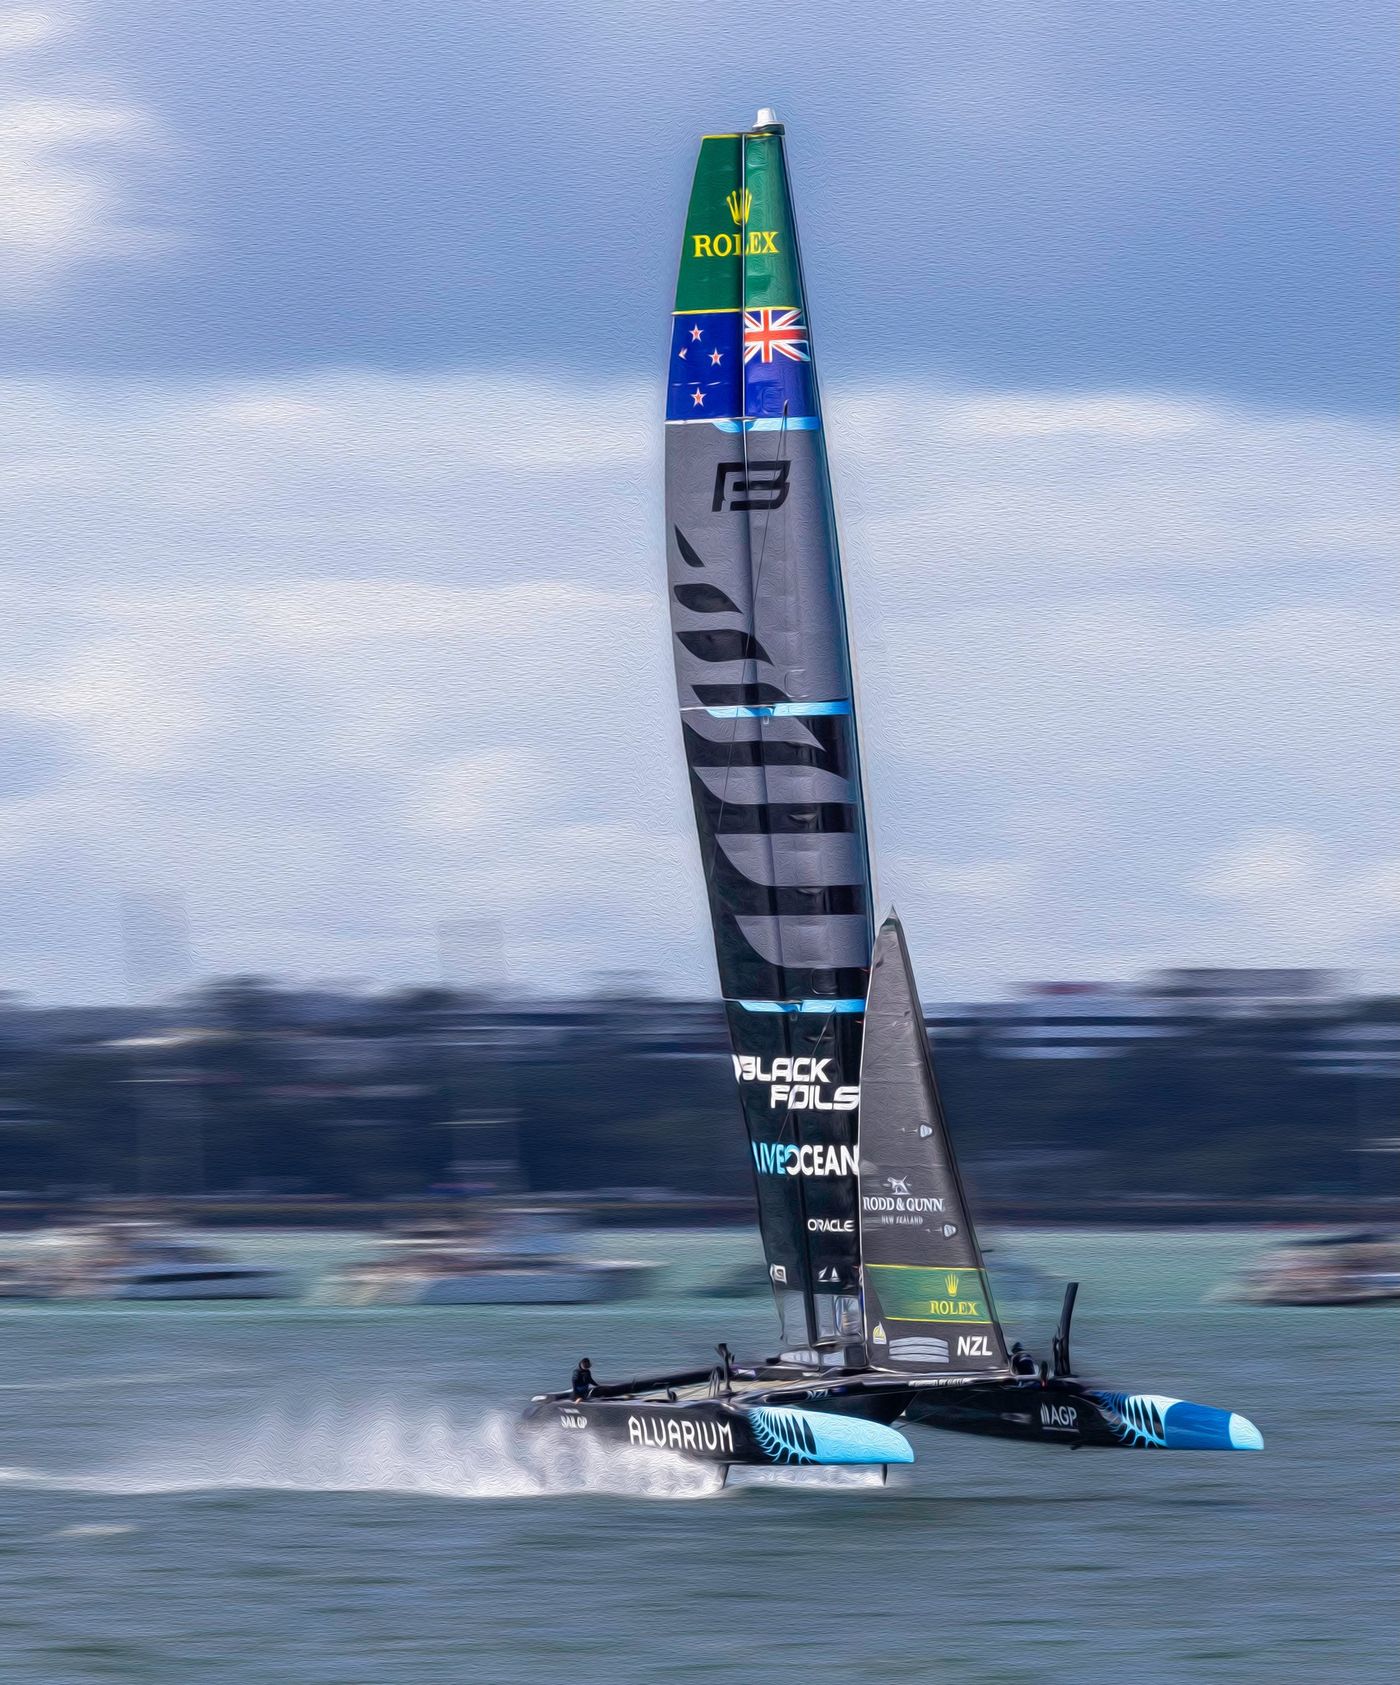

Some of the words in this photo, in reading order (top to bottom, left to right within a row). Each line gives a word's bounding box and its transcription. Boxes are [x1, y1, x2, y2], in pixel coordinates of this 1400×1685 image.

[692, 231, 780, 258] ROLEX
[732, 1054, 832, 1084] BLACK
[770, 1084, 859, 1111] FOILS
[863, 1196, 895, 1211] RODD
[896, 1197, 906, 1212] &
[906, 1198, 945, 1213] GUNN
[807, 1218, 855, 1233] ORACLE
[929, 1300, 978, 1316] ROLEX
[957, 1335, 993, 1357] NZL
[628, 1414, 734, 1453] ALVARIUM
